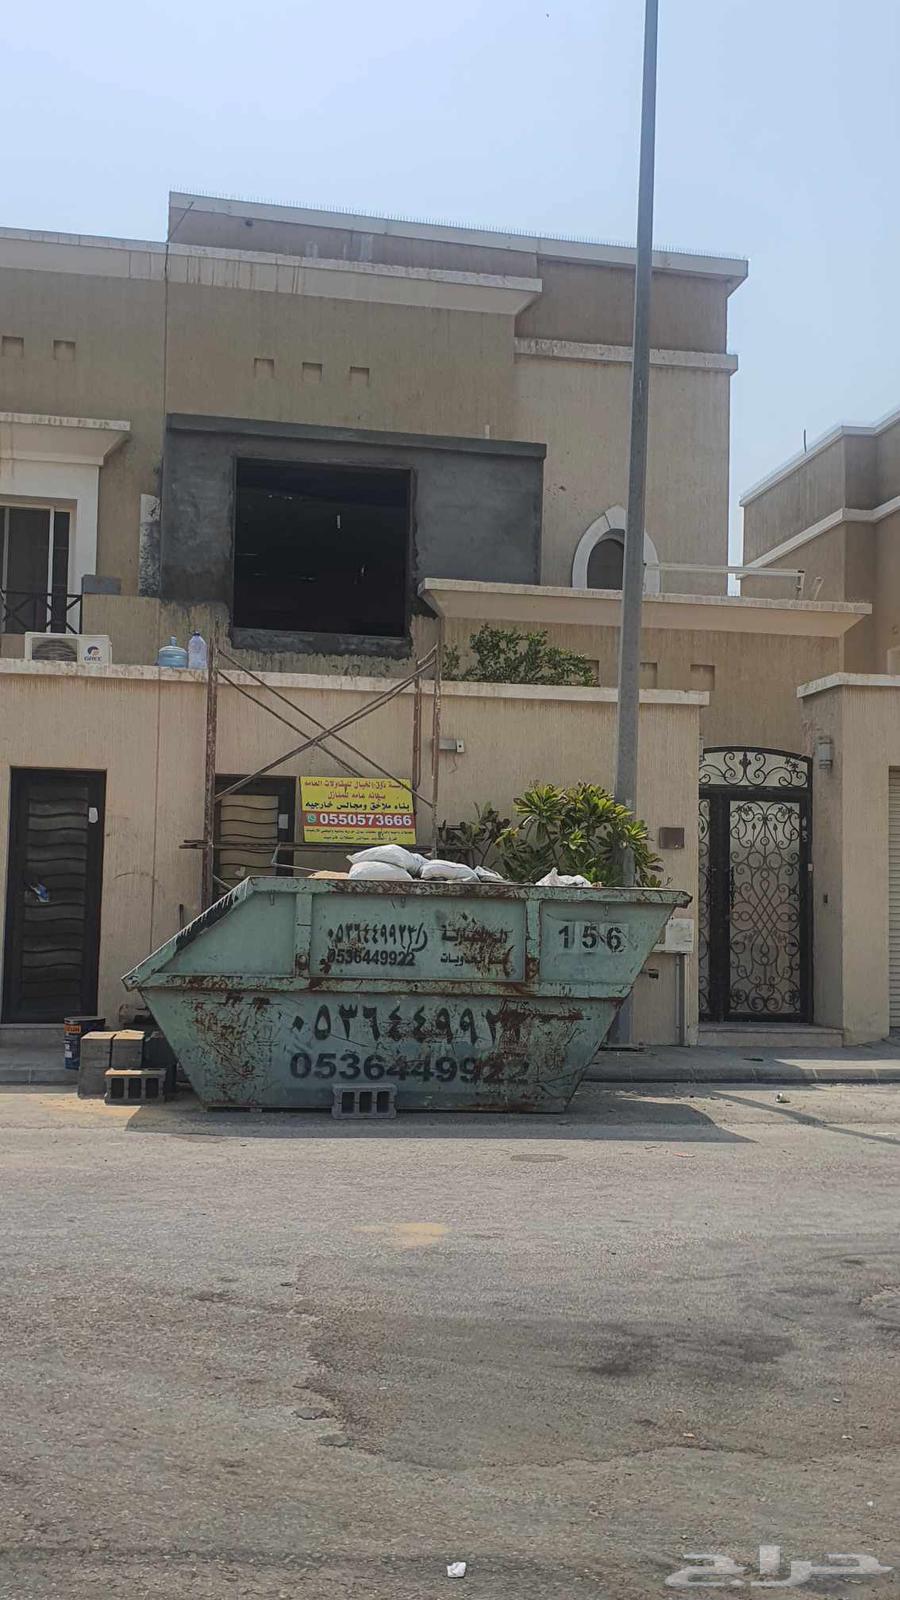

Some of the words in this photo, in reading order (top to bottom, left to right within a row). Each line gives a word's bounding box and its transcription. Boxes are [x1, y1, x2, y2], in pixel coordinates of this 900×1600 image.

[337, 801, 367, 811] ومجالس
[370, 801, 391, 811] ملاحق
[395, 802, 410, 812] بناء
[319, 812, 412, 826] 0550573666
[557, 924, 625, 953] 156
[328, 948, 416, 967] 0536449922
